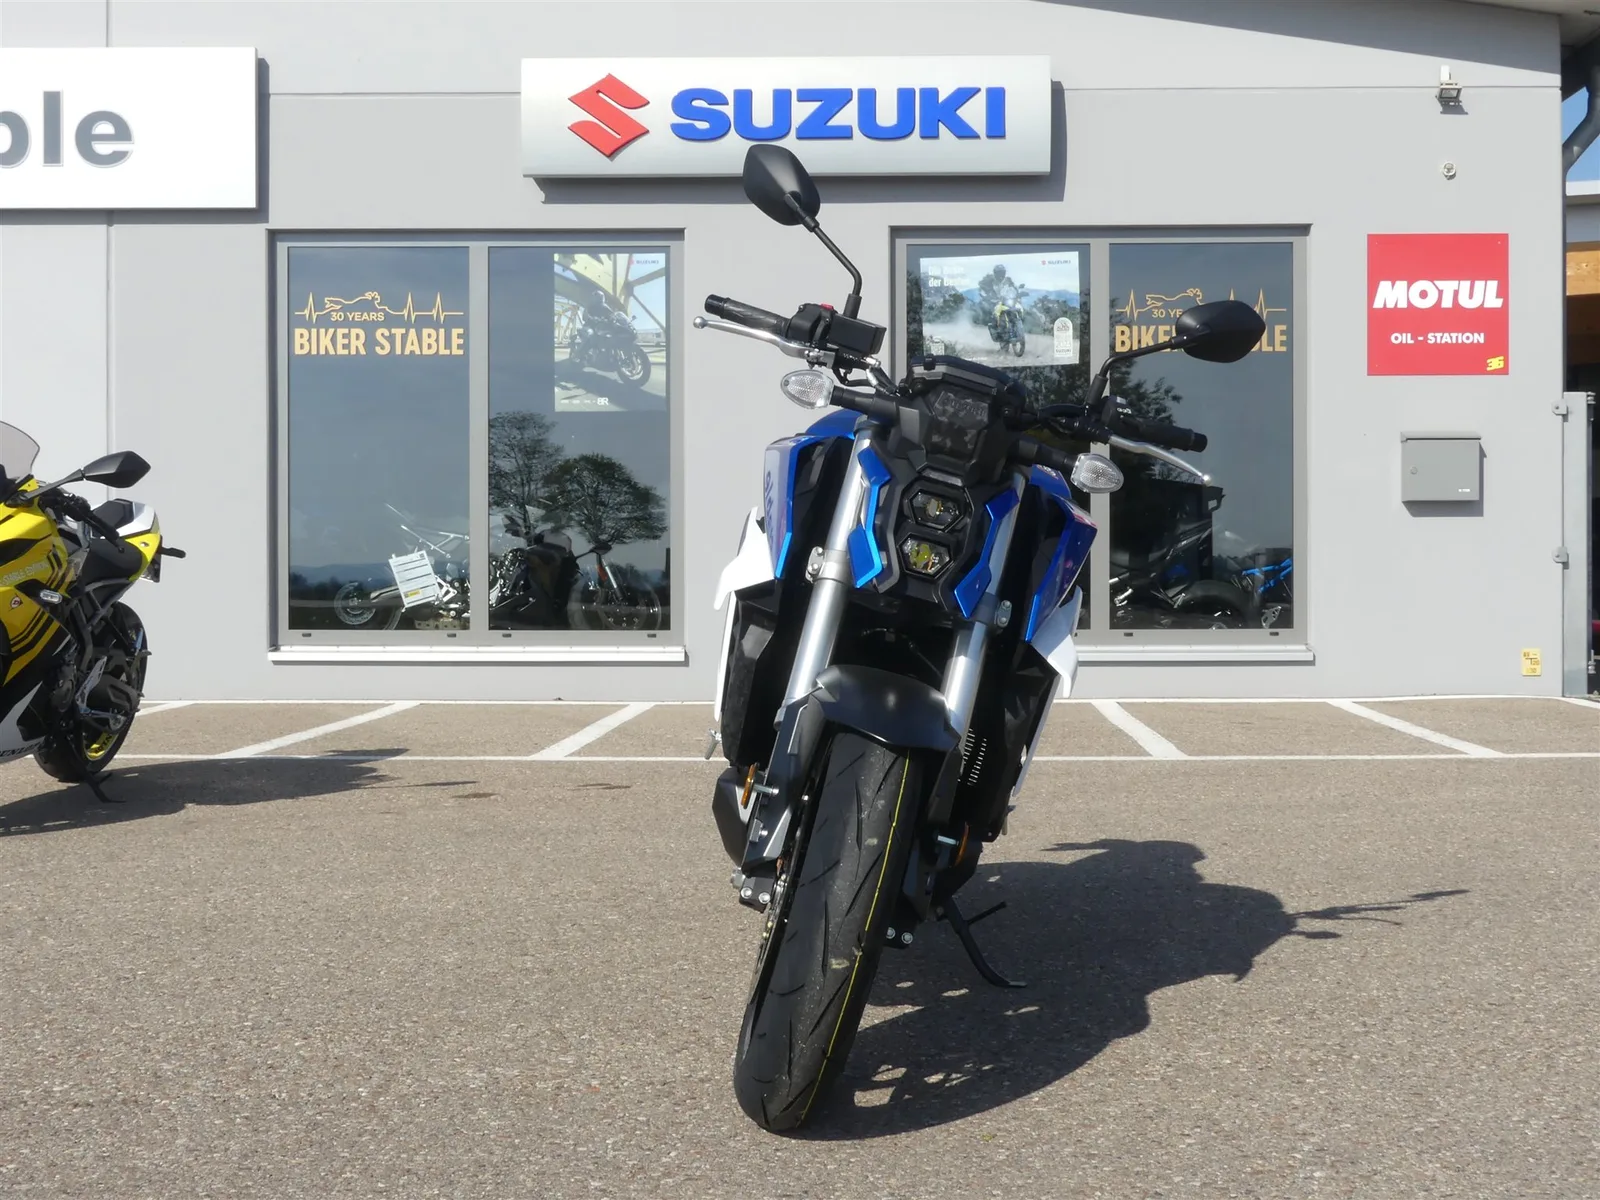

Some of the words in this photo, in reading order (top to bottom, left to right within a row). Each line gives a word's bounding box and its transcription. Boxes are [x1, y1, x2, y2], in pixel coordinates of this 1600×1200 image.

[670, 86, 1006, 141] SUZUKI
[1372, 279, 1504, 309] MOTUL
[330, 312, 344, 321] 30
[347, 312, 385, 321] YEARS
[1152, 309, 1165, 318] 30
[294, 328, 366, 355] BIKER
[375, 328, 464, 355] STABLE
[1115, 325, 1185, 353] BIKE
[1390, 333, 1414, 344] OIL
[1427, 332, 1485, 344] STATION
